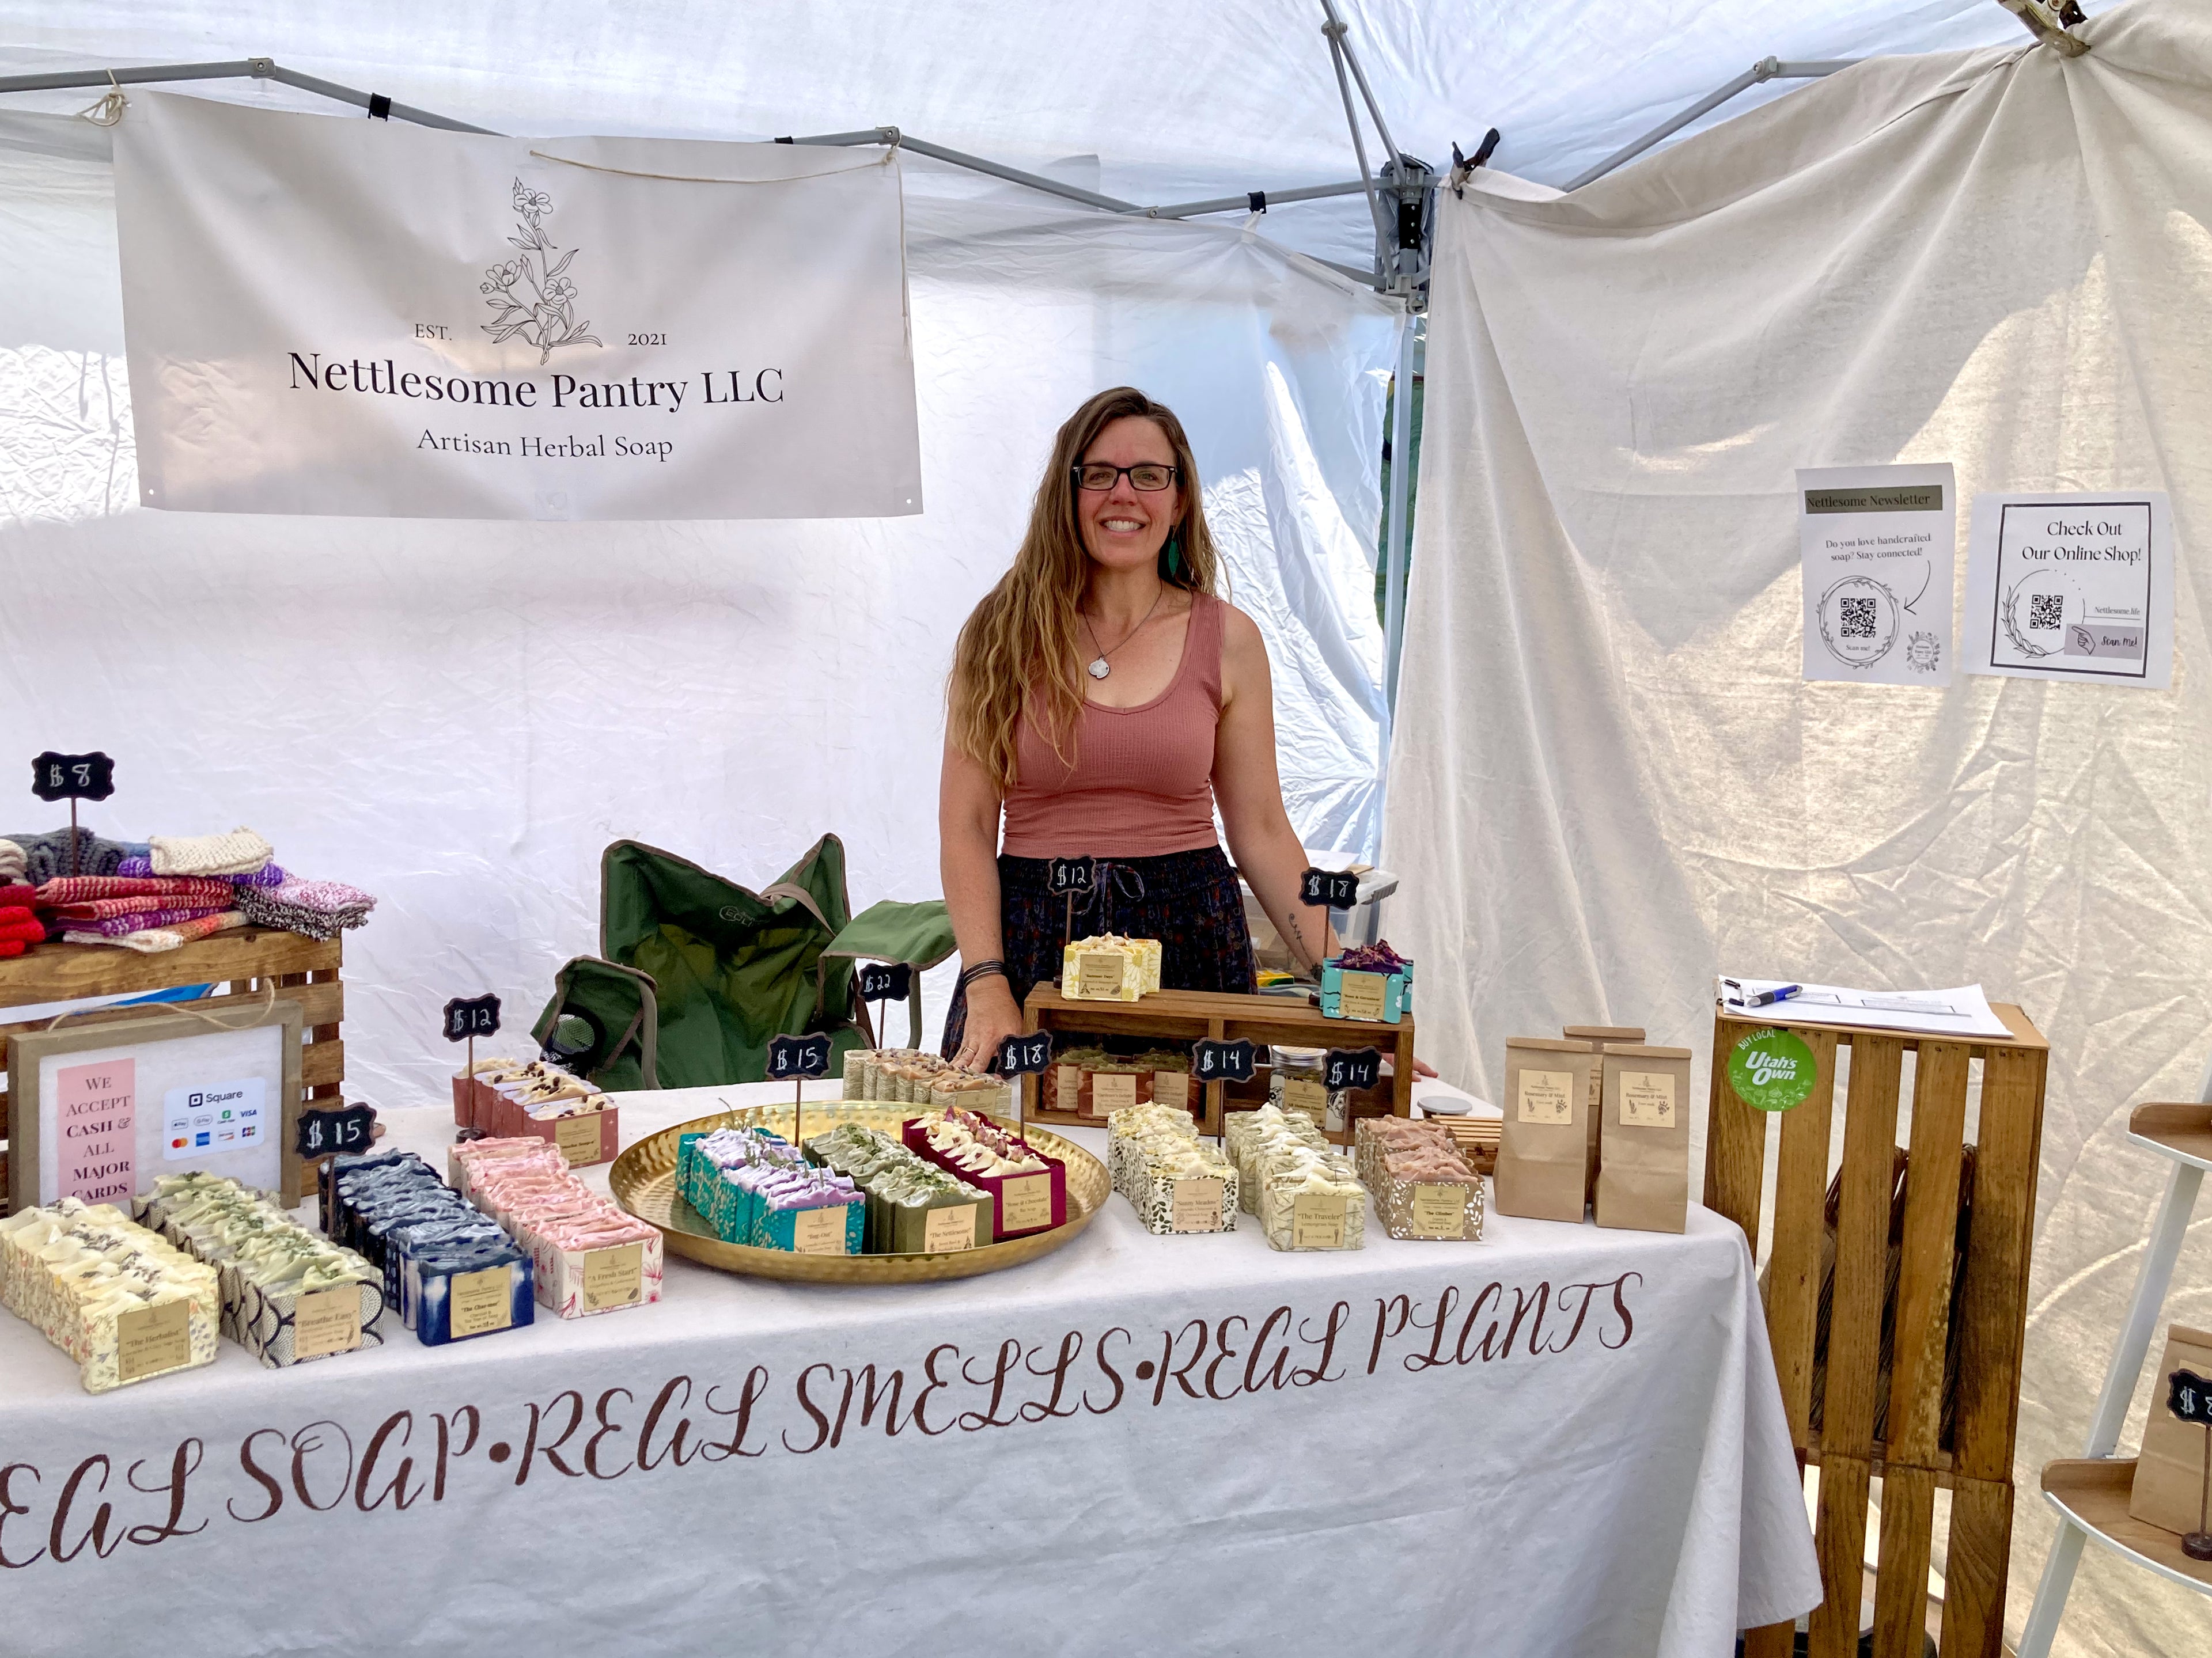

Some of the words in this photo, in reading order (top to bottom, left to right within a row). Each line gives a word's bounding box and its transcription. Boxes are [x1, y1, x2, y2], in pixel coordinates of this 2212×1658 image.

[414, 322, 453, 342] EST.
[627, 331, 668, 347] 2021
[286, 351, 537, 408] Nettlesome
[551, 372, 690, 413] Pantry
[700, 367, 785, 404] LLC
[415, 428, 512, 458] Artisan
[520, 431, 607, 459] Herbal
[614, 435, 674, 462] Soap
[1808, 496, 1867, 508] Nettlesome
[1870, 494, 1931, 507] Newsletter
[2047, 521, 2093, 536] Check
[2097, 521, 2123, 536] Out
[1825, 539, 1838, 549] Do
[1839, 540, 1856, 549] you
[1857, 537, 1875, 547] love
[1877, 533, 1931, 545] handcrafted
[1831, 552, 1854, 563] soap?
[1856, 550, 1873, 560] Stay
[1876, 547, 1923, 559] connected!
[2022, 547, 2051, 560] Our
[2054, 545, 2101, 560] Online
[2104, 545, 2141, 566] Shop!
[2101, 635, 2122, 647] Scan
[1737, 1037, 1753, 1050] BUY
[1752, 1029, 1776, 1041] LOCAL
[1745, 1051, 1798, 1069] Utah's
[86, 1076, 112, 1091] WE
[1752, 1067, 1796, 1086] Own
[206, 1090, 243, 1103] Square
[66, 1095, 131, 1117] ACCEPT
[240, 1109, 257, 1118] VISA
[66, 1120, 113, 1139] CASH
[118, 1117, 131, 1129] &
[83, 1142, 115, 1158] ALL
[73, 1160, 131, 1182] MAJOR
[71, 1182, 128, 1201] CARDS
